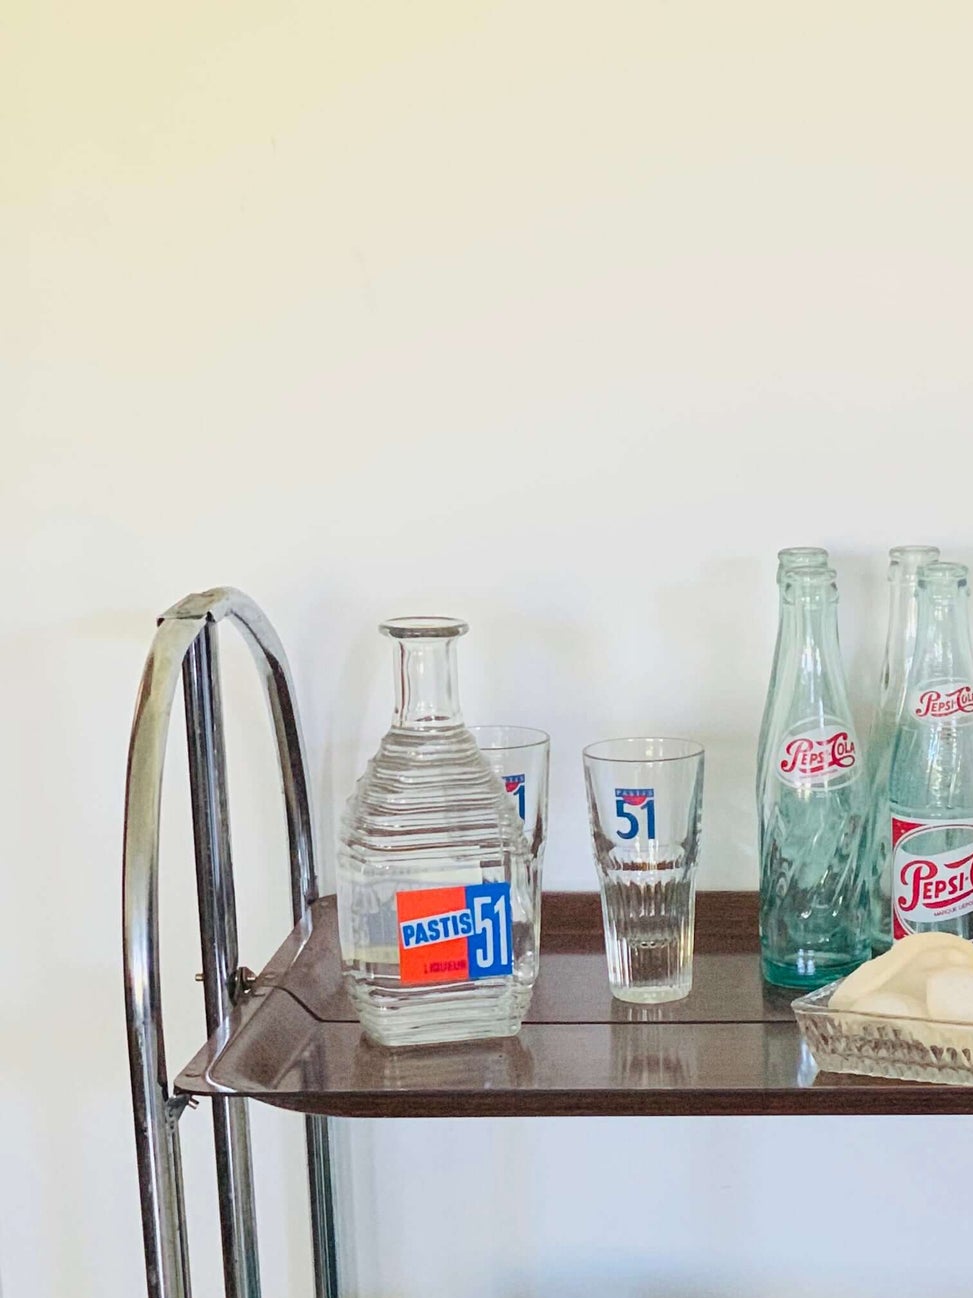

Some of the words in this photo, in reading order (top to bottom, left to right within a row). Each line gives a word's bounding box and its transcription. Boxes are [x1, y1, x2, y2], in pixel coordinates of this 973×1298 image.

[616, 799, 655, 839] 51
[402, 912, 472, 947] PASTIS
[473, 895, 508, 968] 51
